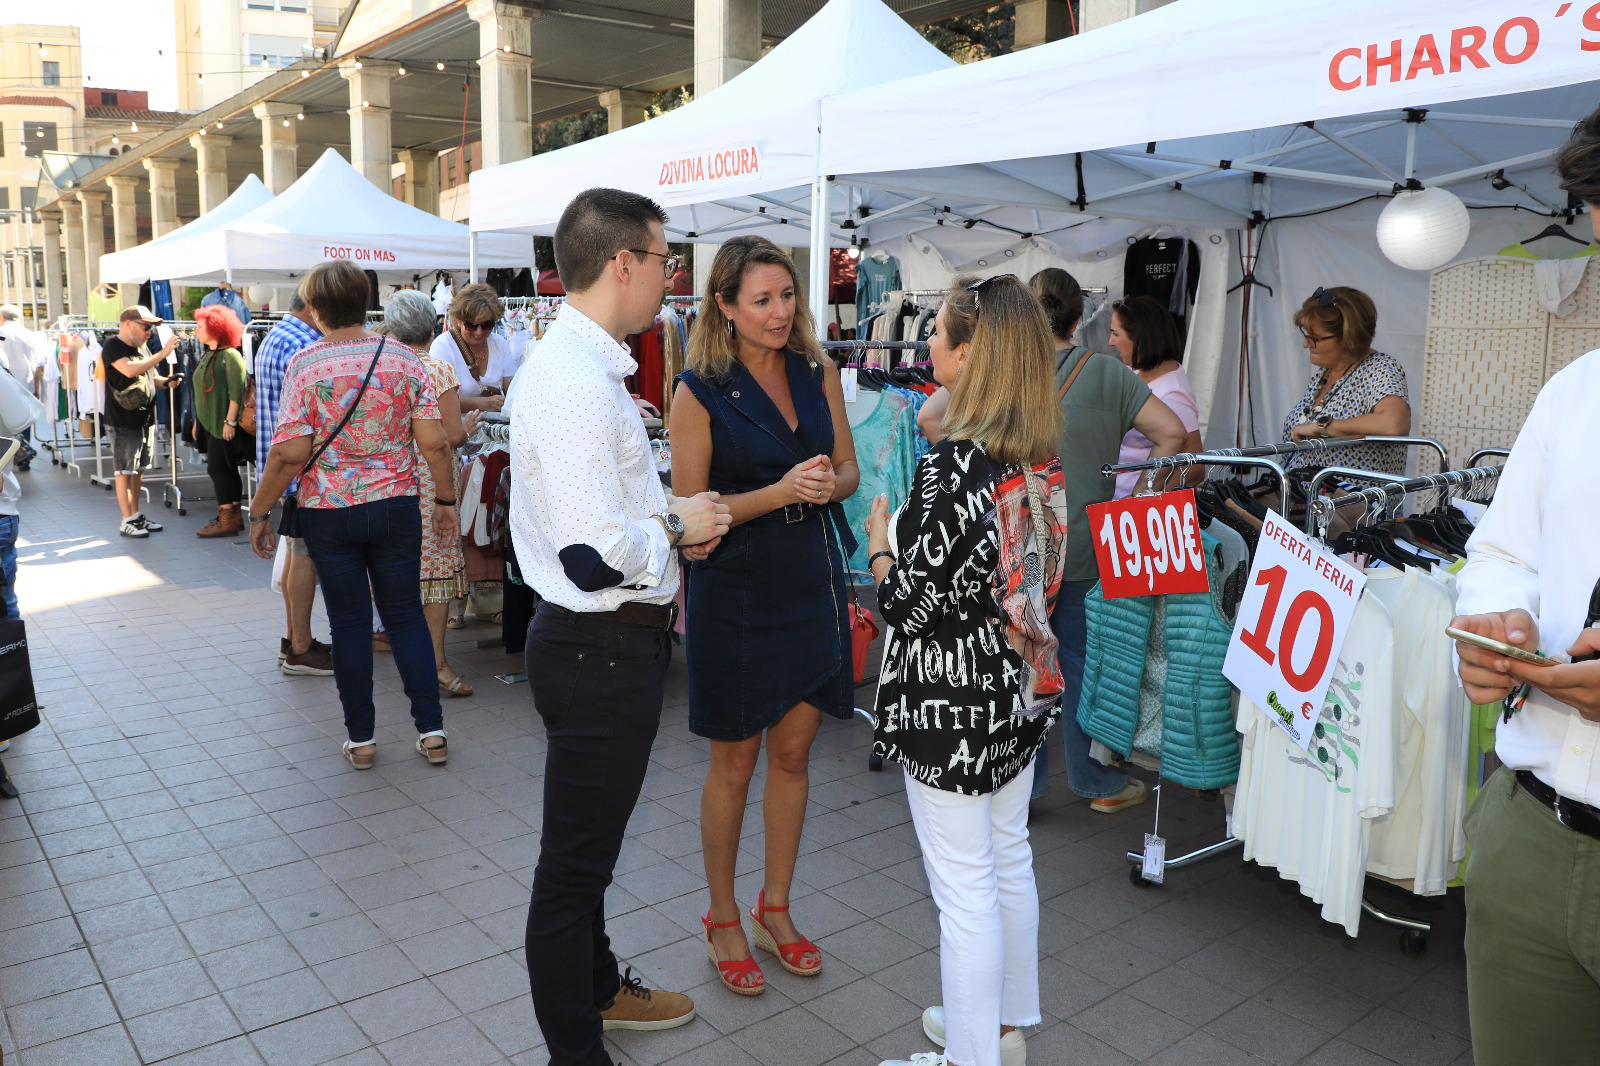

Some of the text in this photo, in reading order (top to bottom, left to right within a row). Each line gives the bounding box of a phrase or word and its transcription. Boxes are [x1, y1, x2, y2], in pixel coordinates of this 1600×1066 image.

[658, 146, 759, 185] DIVINA LOCURA
[323, 246, 396, 262] FOOT ON MAS
[1145, 263, 1177, 274] PERFECT
[1100, 501, 1203, 591] 19,90€
[1265, 520, 1355, 597] OFERTA FERIA
[1239, 564, 1335, 693] 10
